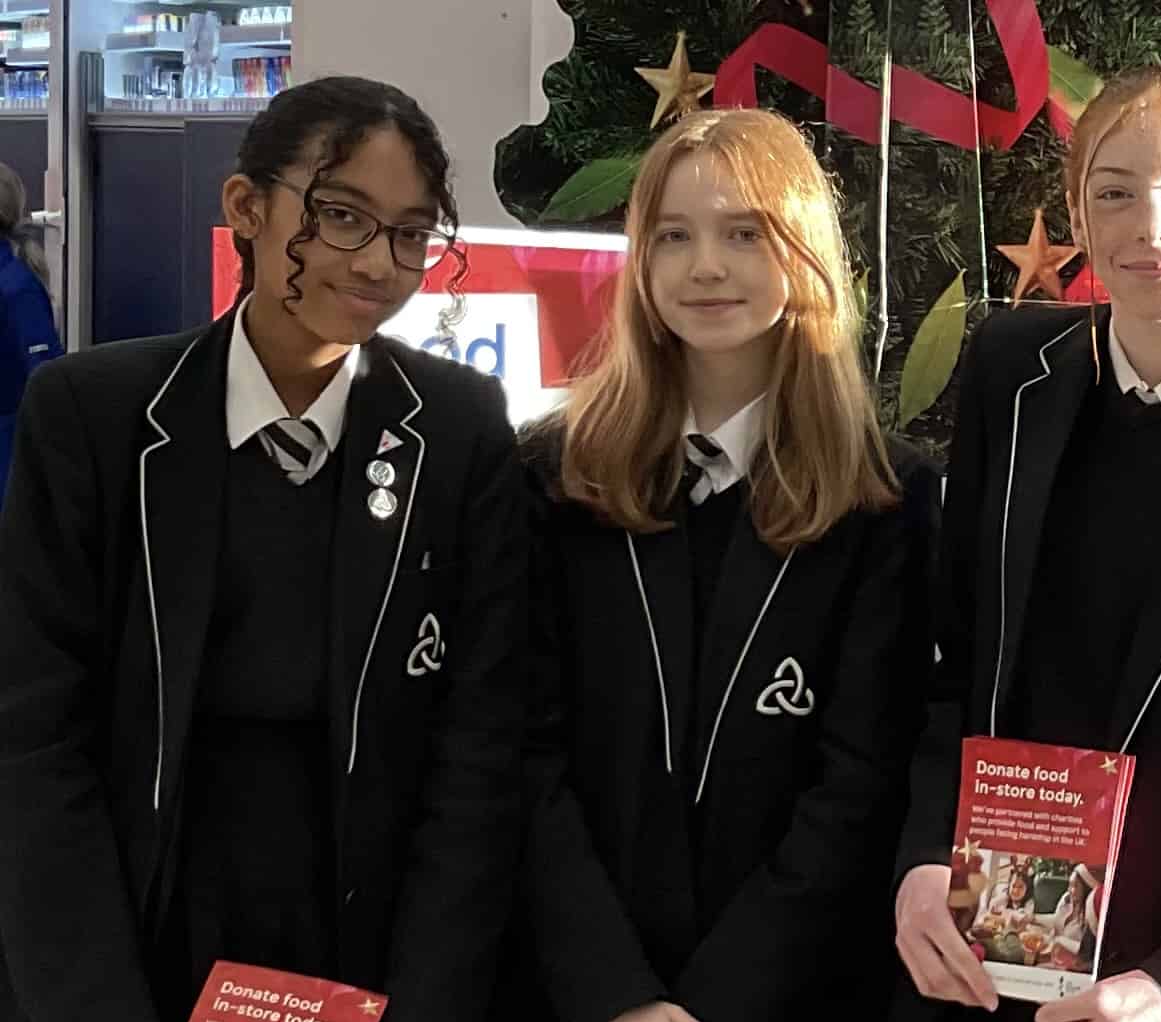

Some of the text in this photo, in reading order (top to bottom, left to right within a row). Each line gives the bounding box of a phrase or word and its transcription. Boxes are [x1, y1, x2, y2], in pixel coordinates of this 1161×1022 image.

[976, 760, 1069, 784] Donate food
[1039, 787, 1084, 807] today.
[220, 981, 324, 1013] Donate food
